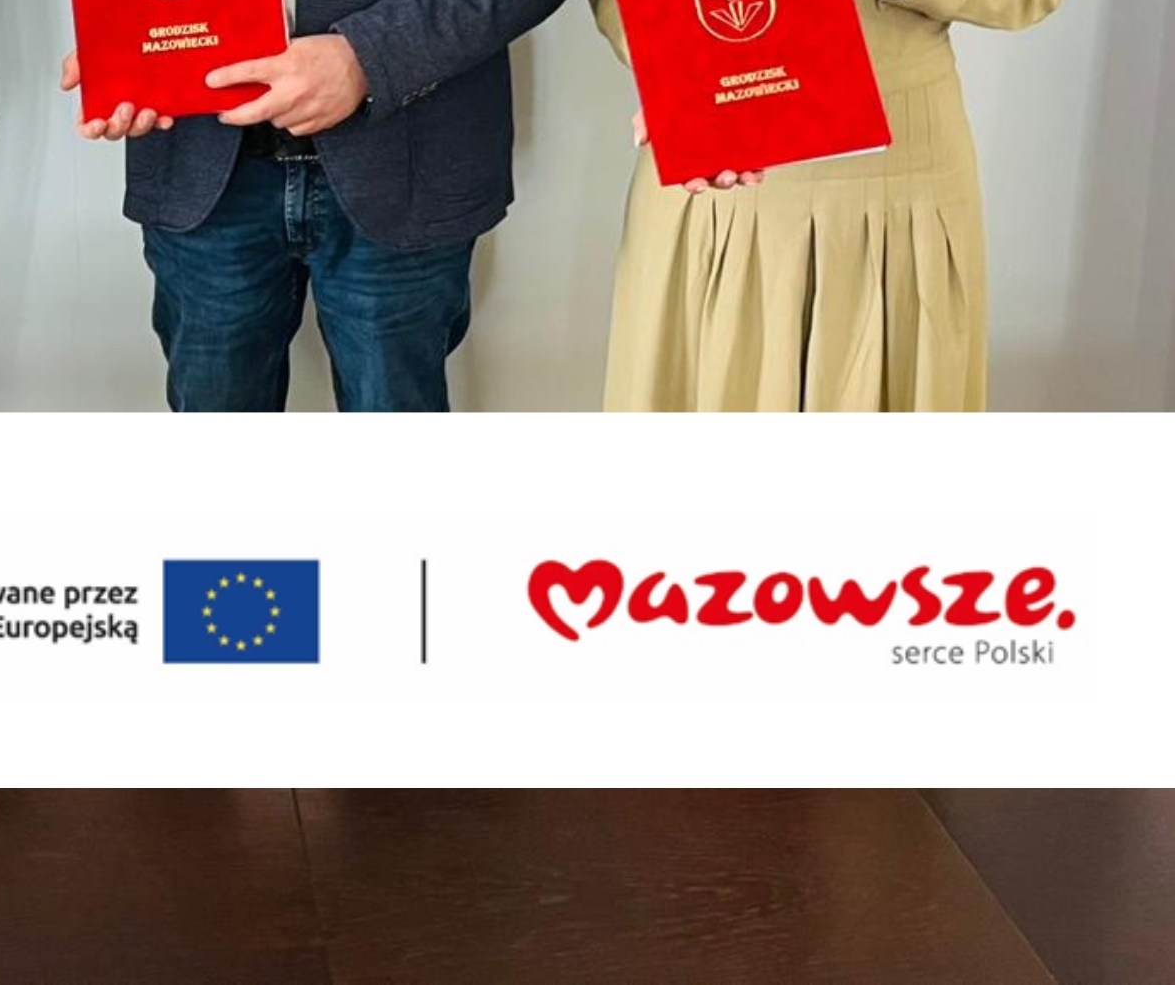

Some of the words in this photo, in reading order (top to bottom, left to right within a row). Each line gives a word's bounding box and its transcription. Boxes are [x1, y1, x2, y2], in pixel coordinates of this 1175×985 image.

[148, 22, 210, 38] GRODZISK
[142, 35, 219, 53] MAZOWIECKI
[719, 65, 787, 87] GRODZISK
[715, 79, 800, 104] MAZOWIECKI
